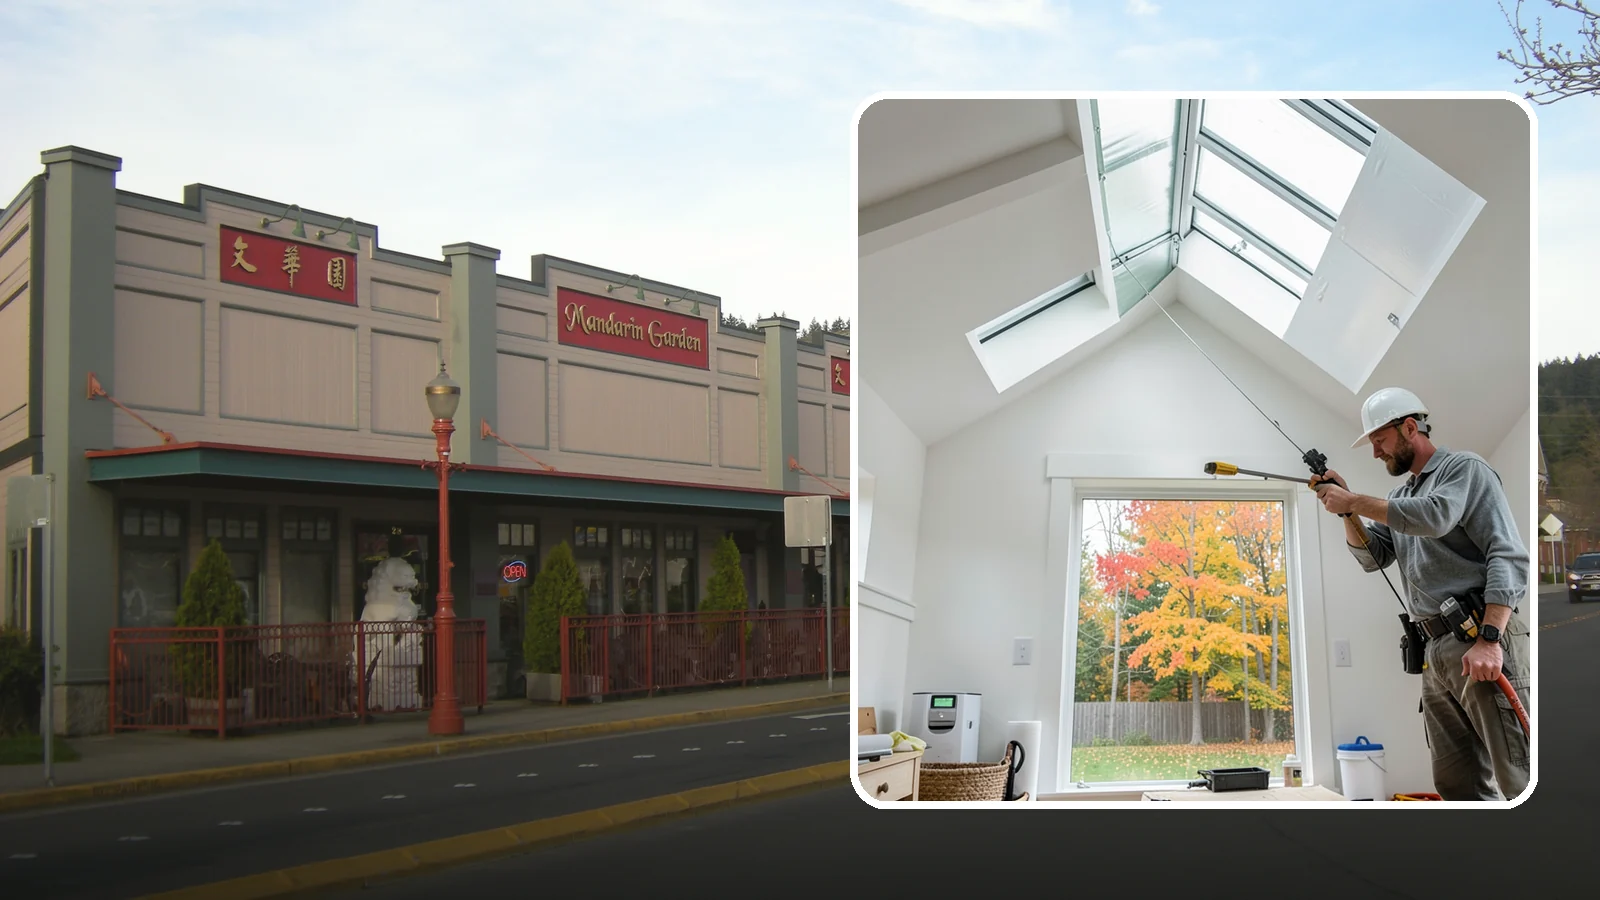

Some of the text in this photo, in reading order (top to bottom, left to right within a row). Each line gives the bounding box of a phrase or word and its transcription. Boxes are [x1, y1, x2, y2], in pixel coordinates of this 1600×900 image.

[231, 235, 346, 291] 文華園
[564, 302, 702, 352] Mandarin Garden
[503, 565, 527, 578] OPEN
